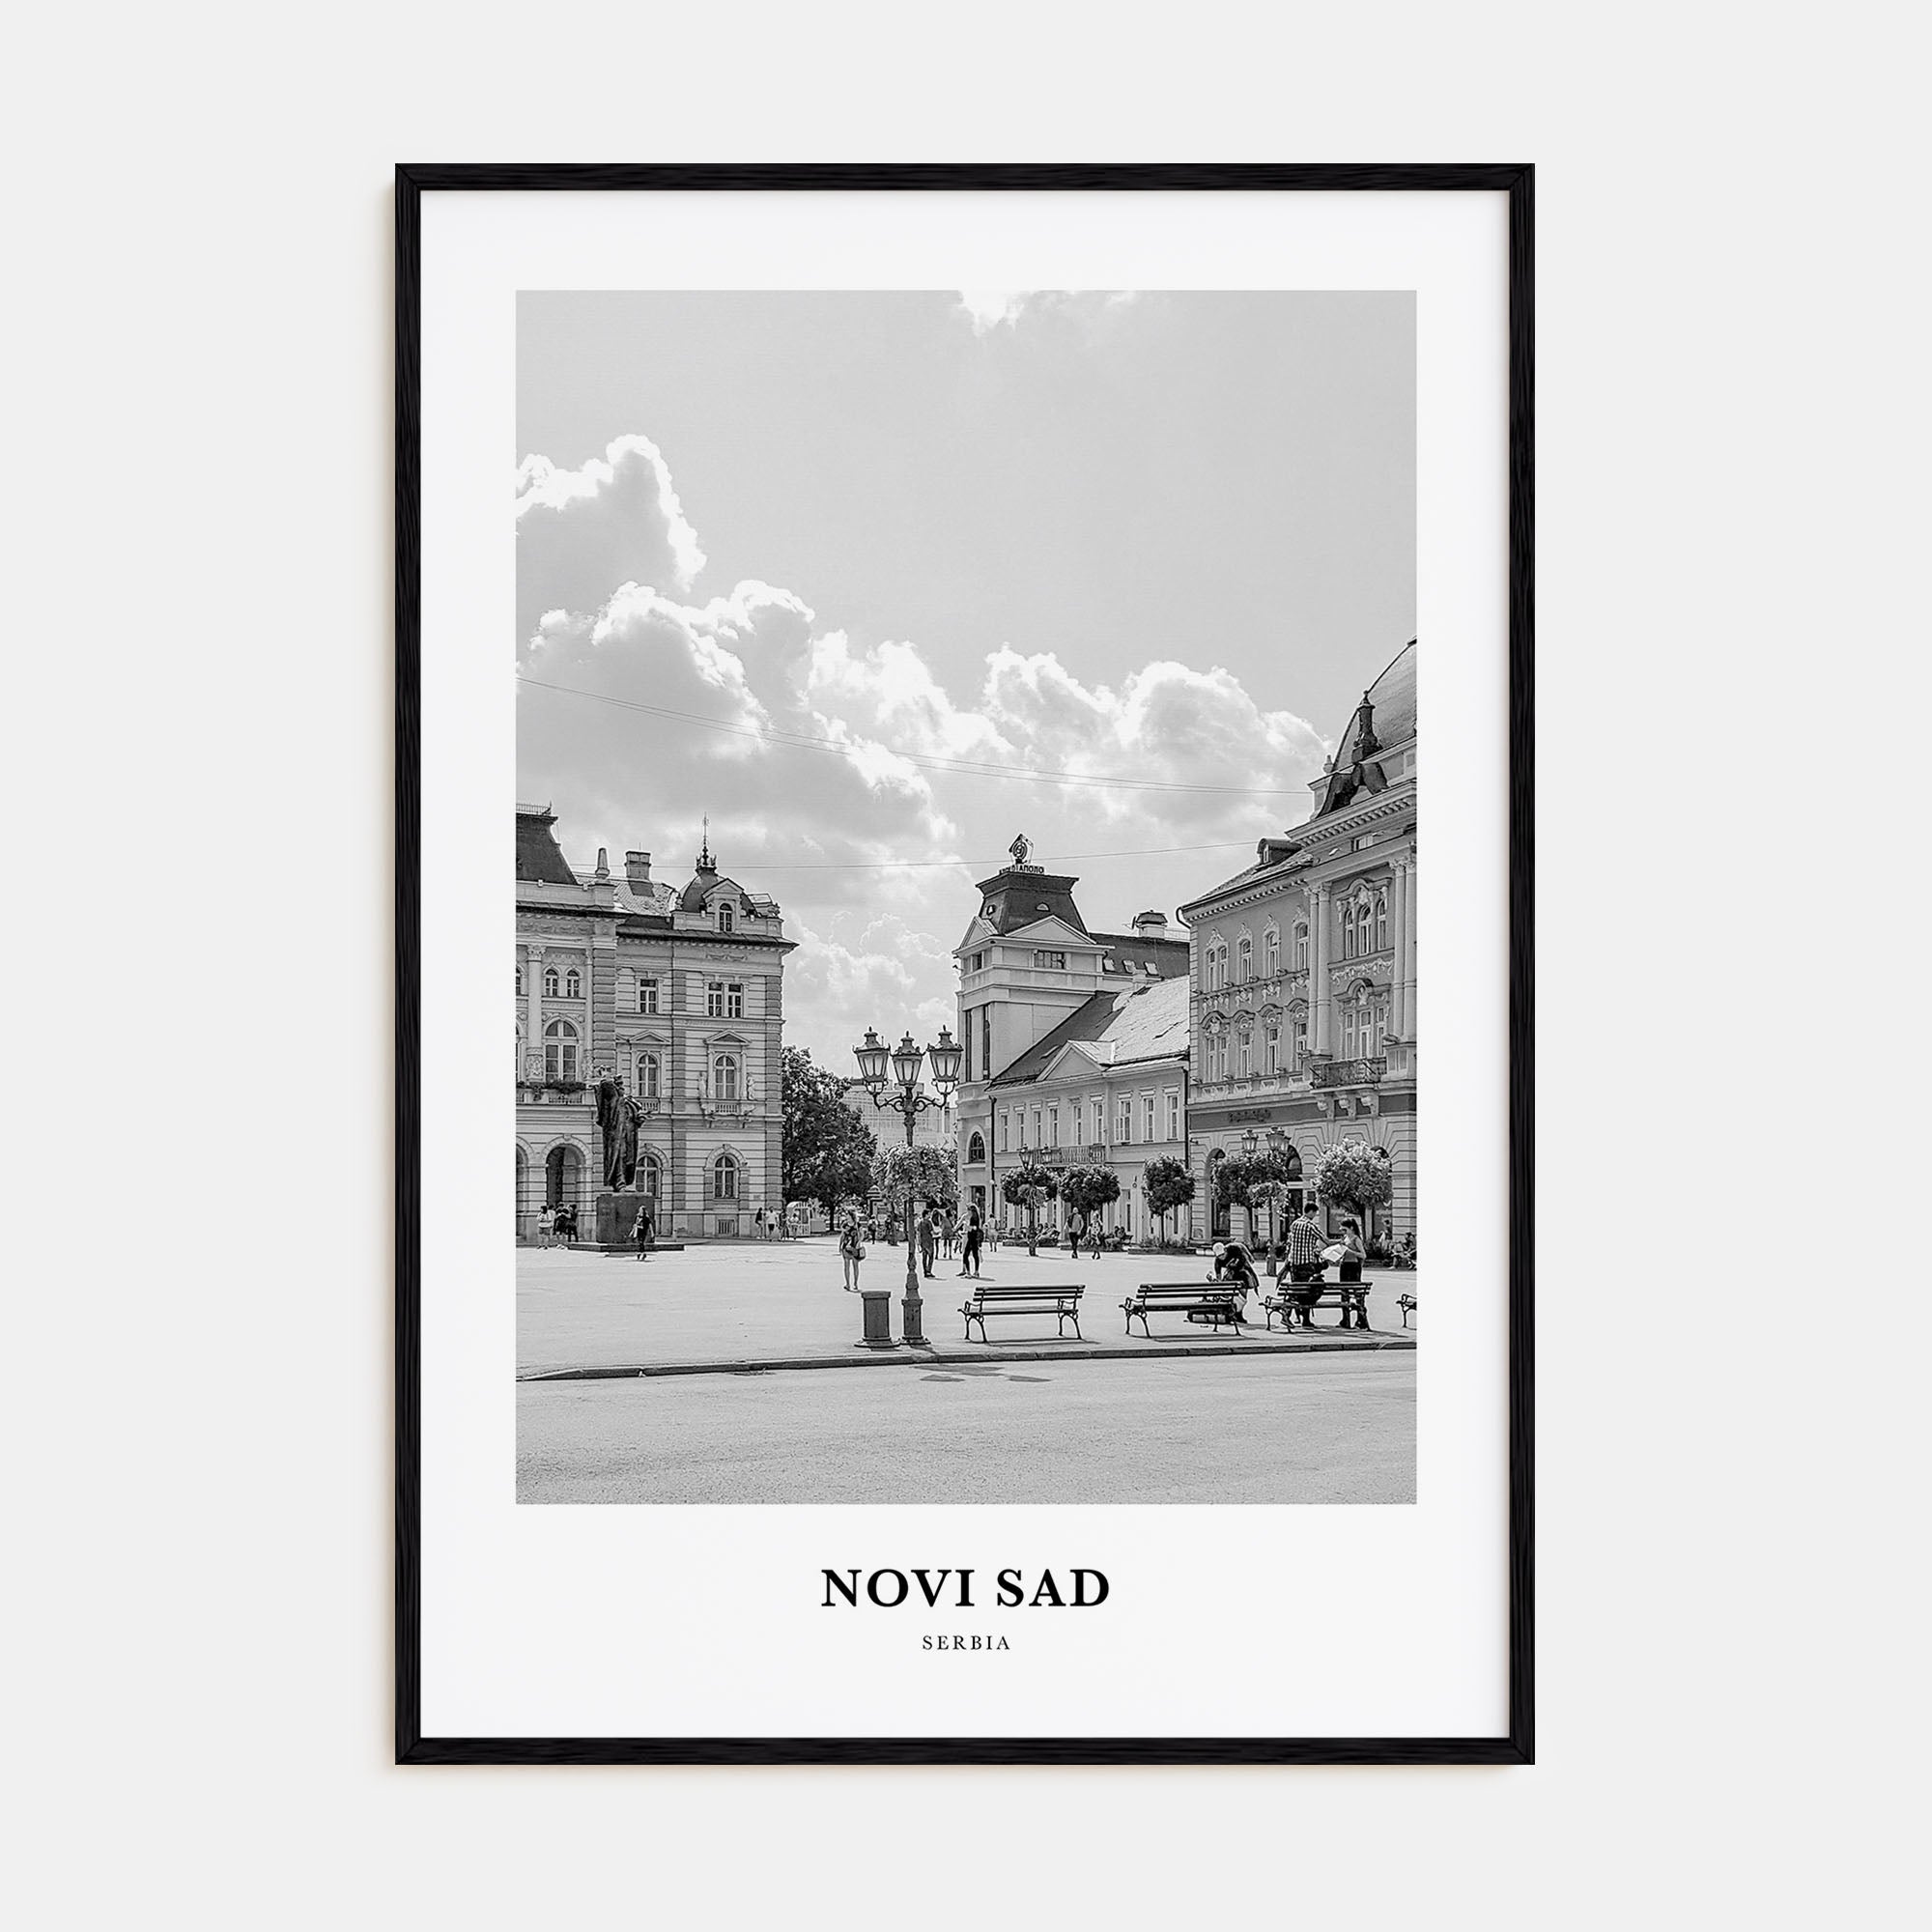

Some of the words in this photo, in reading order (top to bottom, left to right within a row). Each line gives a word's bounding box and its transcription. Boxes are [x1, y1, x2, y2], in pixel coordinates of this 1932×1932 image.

[820, 1568, 975, 1607] NOVI
[996, 1568, 1109, 1607] SAD
[923, 1634, 1010, 1650] SERBIA
